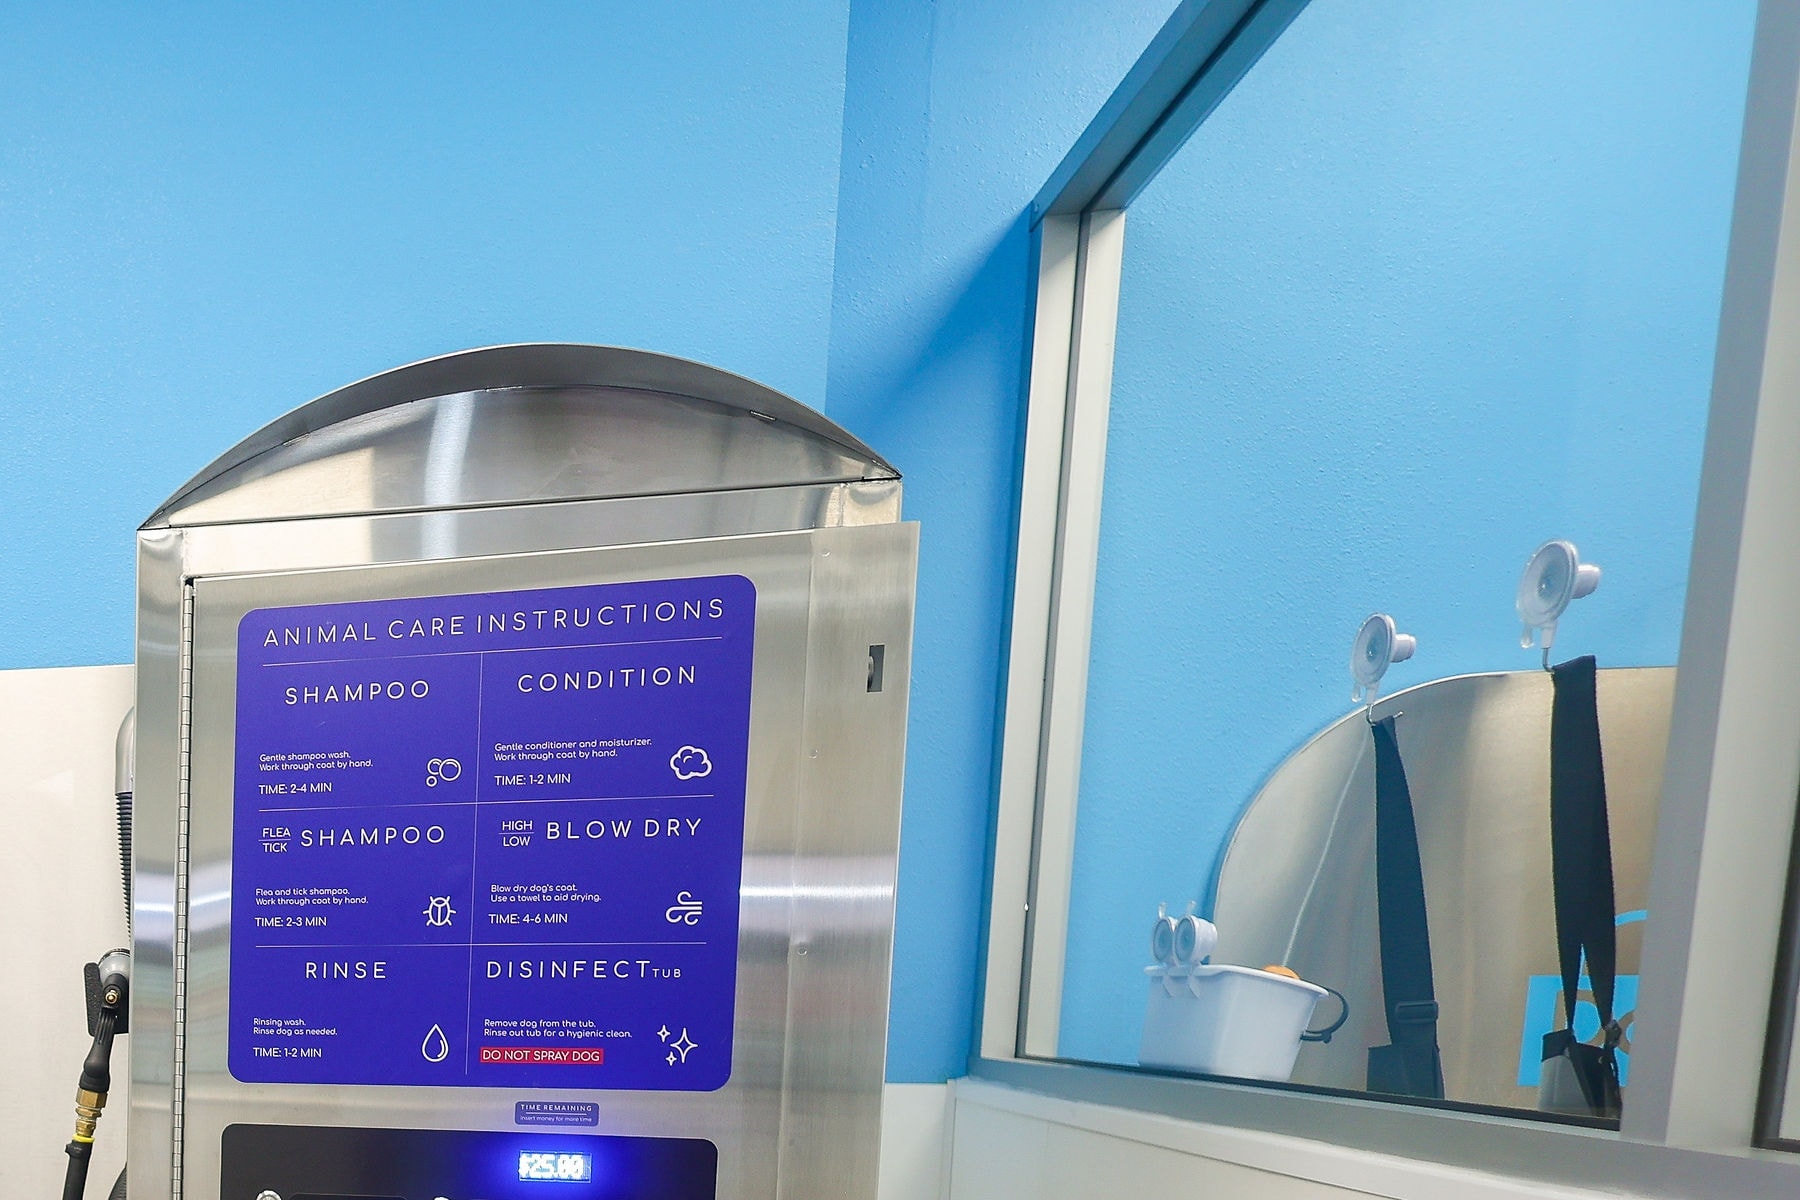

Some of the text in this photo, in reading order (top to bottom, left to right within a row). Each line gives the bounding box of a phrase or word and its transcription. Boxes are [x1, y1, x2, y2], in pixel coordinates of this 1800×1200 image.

[263, 598, 724, 648] ANIMAL CARE INSTRUCTIONS
[517, 665, 696, 694] CONDITION
[284, 679, 430, 706] SHAMPOO
[494, 738, 652, 752] Gentle conditioner and moisturizer.
[259, 751, 351, 762] Gentle shampoo wash.
[494, 749, 618, 761] Work through coat by hand.
[259, 759, 374, 772] Work through coat by hand.
[494, 773, 571, 786] TIME: 1-2 MIN
[258, 782, 332, 795] TIME: 2-4 MIN
[502, 820, 533, 831] HIGH
[546, 818, 702, 840] BLOW DRY
[262, 827, 291, 838] FLEA
[300, 825, 445, 847] SHAMPOO
[503, 835, 531, 847] LOW
[262, 842, 288, 853] TICK
[255, 887, 350, 897] Flea and tick shampoo.
[491, 883, 578, 894] Blow dry dog's coat.
[255, 896, 369, 907] Work through coat by hand.
[491, 894, 507, 903] Use
[517, 893, 540, 902] towel
[542, 894, 552, 902] to
[554, 893, 568, 902] aid
[570, 893, 601, 903] drying.
[254, 916, 327, 927] TIME: 2-3 MIN
[488, 913, 568, 924] TIME: 4-6 MIN
[305, 962, 387, 979] RINSE
[486, 960, 681, 978] DISINFECT TUB
[253, 1017, 306, 1027] Rinsing wash.
[484, 1018, 596, 1029] Remove dog from the tub.
[253, 1027, 275, 1035] Rinse
[276, 1027, 292, 1036] dog
[305, 1027, 338, 1036] needed.
[484, 1028, 507, 1037] Rinse
[509, 1029, 524, 1037] out
[526, 1028, 541, 1037] tub
[543, 1028, 556, 1037] for
[566, 1029, 604, 1039] hygienic
[606, 1029, 632, 1038] clean.
[252, 1047, 322, 1058] TIME: 1-2 MIN
[482, 1050, 600, 1062] DO NOT SPRAY DOG
[543, 1104, 592, 1112] REMAINING
[519, 1153, 584, 1180] $25.00
